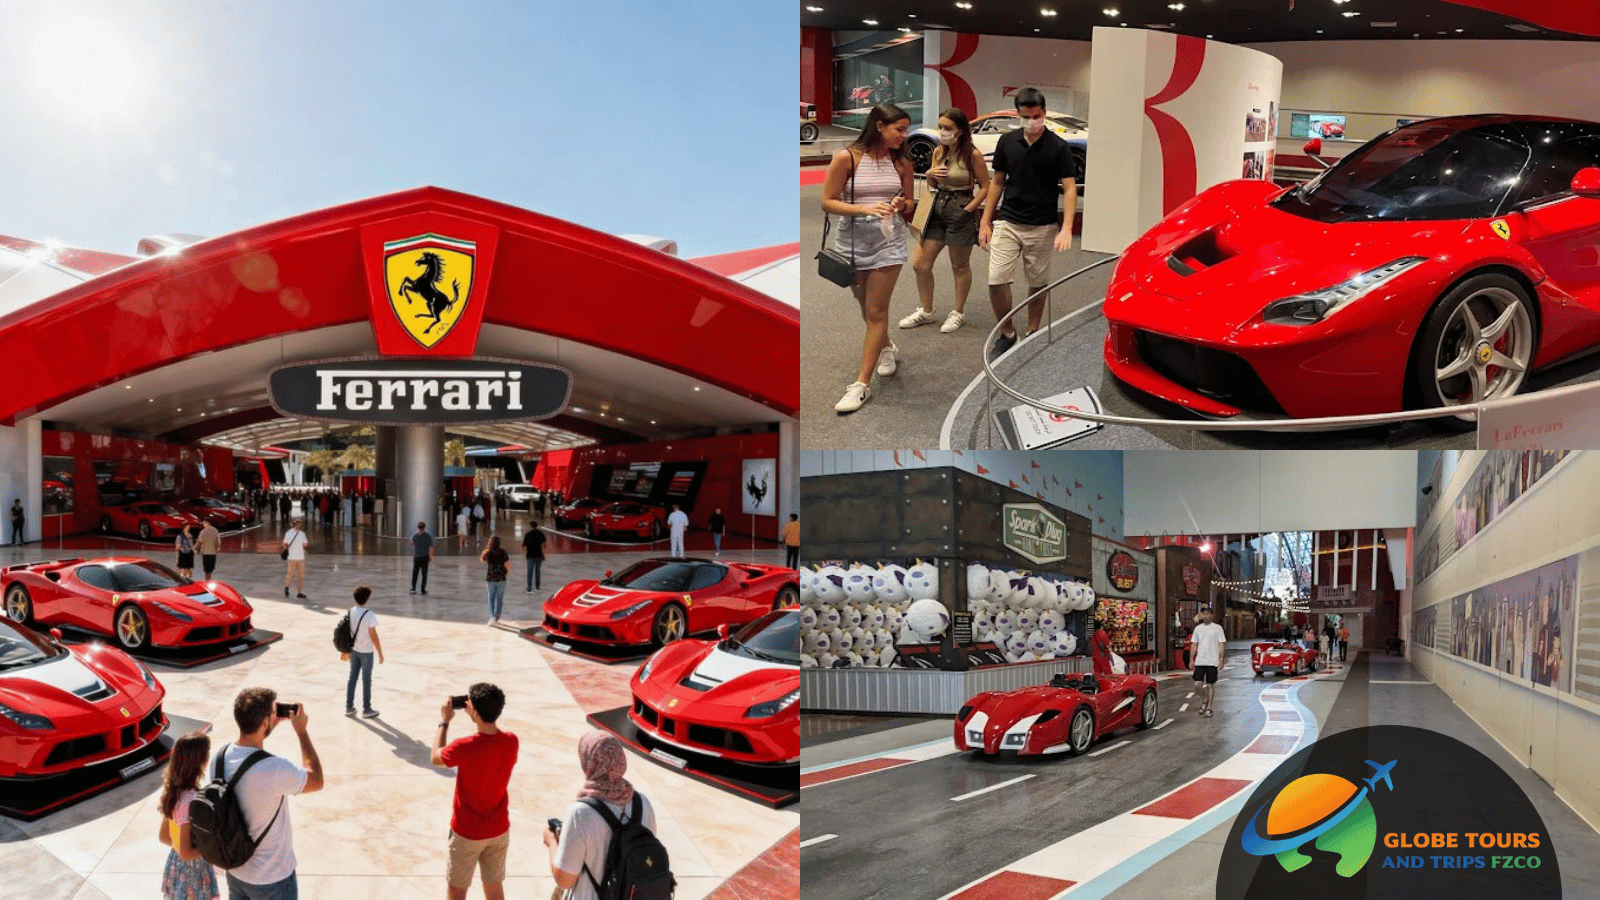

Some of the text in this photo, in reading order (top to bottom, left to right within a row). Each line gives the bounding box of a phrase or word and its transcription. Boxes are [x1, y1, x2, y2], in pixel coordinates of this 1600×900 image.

[316, 370, 523, 411] Ferrari
[1494, 421, 1563, 442] LaFerrari
[1008, 509, 1063, 545] Spark Plug
